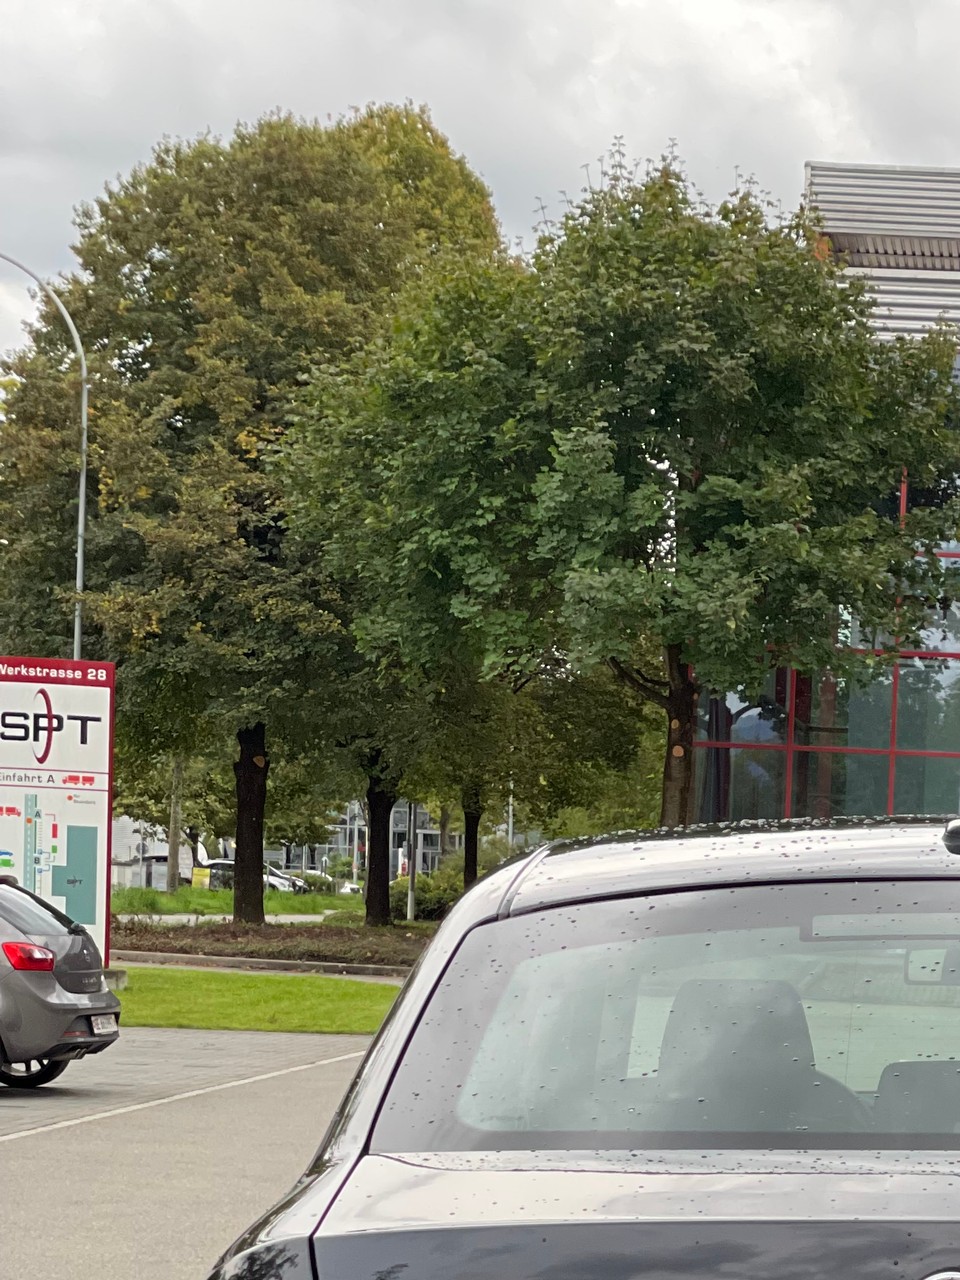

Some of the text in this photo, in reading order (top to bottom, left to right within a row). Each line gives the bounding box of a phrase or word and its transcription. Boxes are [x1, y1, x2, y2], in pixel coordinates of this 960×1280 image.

[87, 668, 107, 681] 28
[0, 711, 102, 745] SPT
[0, 772, 55, 784] infahrt A
